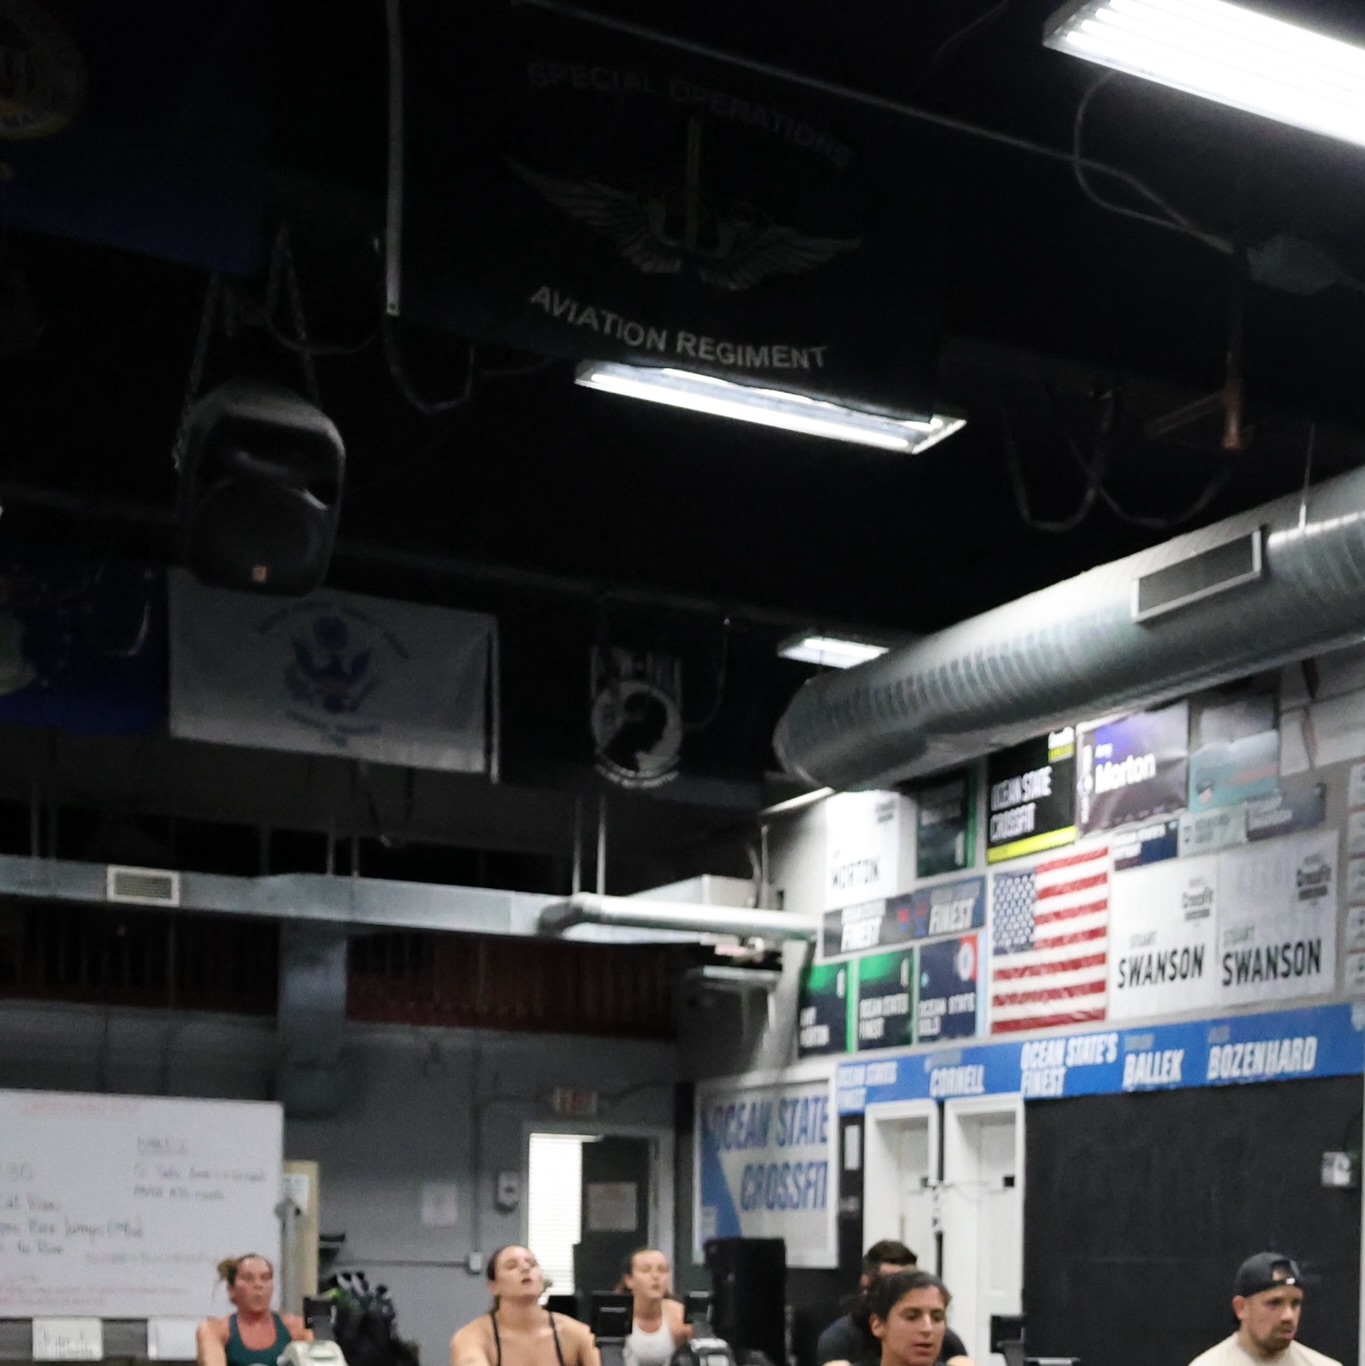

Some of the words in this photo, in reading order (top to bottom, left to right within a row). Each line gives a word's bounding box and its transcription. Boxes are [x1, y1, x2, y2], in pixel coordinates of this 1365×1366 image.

[526, 61, 655, 96] SPECIAL
[667, 78, 850, 168] OPERATIONS
[530, 285, 668, 352] AVIATION
[675, 331, 828, 370] REGIMENT
[1095, 753, 1157, 794] Morton
[1117, 943, 1205, 989] SWANSON
[1222, 938, 1322, 987] SWANSON
[1020, 1038, 1066, 1071] OCEAN
[1066, 1032, 1119, 1067] STATE'S
[1123, 1049, 1185, 1091] BALLEK
[1206, 1036, 1318, 1081] BOZENHARD
[713, 1099, 770, 1151] OCEAN
[776, 1097, 829, 1147] STATE
[740, 1160, 828, 1211] CROSSFIT
